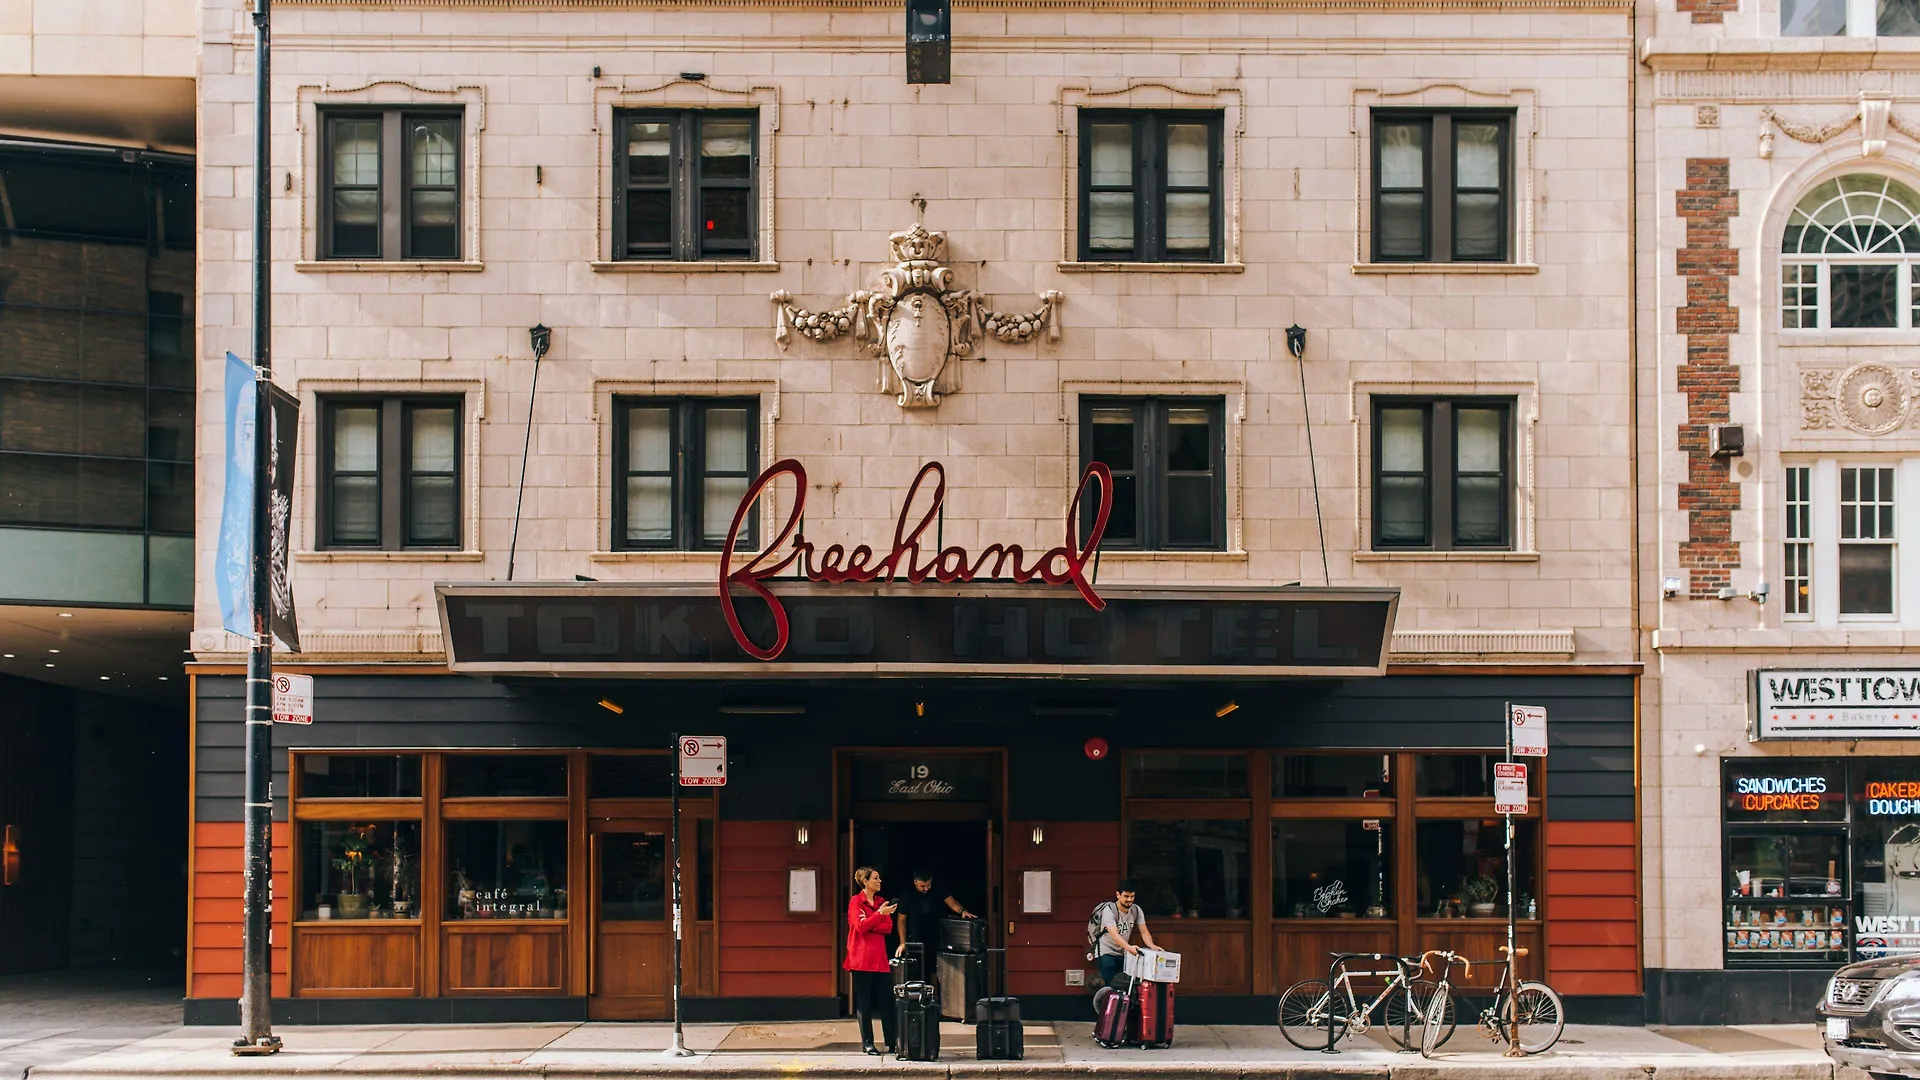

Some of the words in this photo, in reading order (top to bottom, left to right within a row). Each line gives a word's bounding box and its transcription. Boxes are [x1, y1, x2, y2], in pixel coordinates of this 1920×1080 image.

[720, 458, 1113, 661] freehand
[953, 605, 1359, 660] HOTEL
[1842, 712, 1887, 724] Bakery
[911, 765, 929, 779] 19
[888, 780, 922, 794] East
[923, 780, 955, 794] Ohio
[1738, 777, 1827, 794] SANDWICHES
[1745, 794, 1820, 811] CUPCAKES
[475, 888, 508, 900] café
[476, 901, 540, 914] integral
[1855, 915, 1910, 934] WEST
